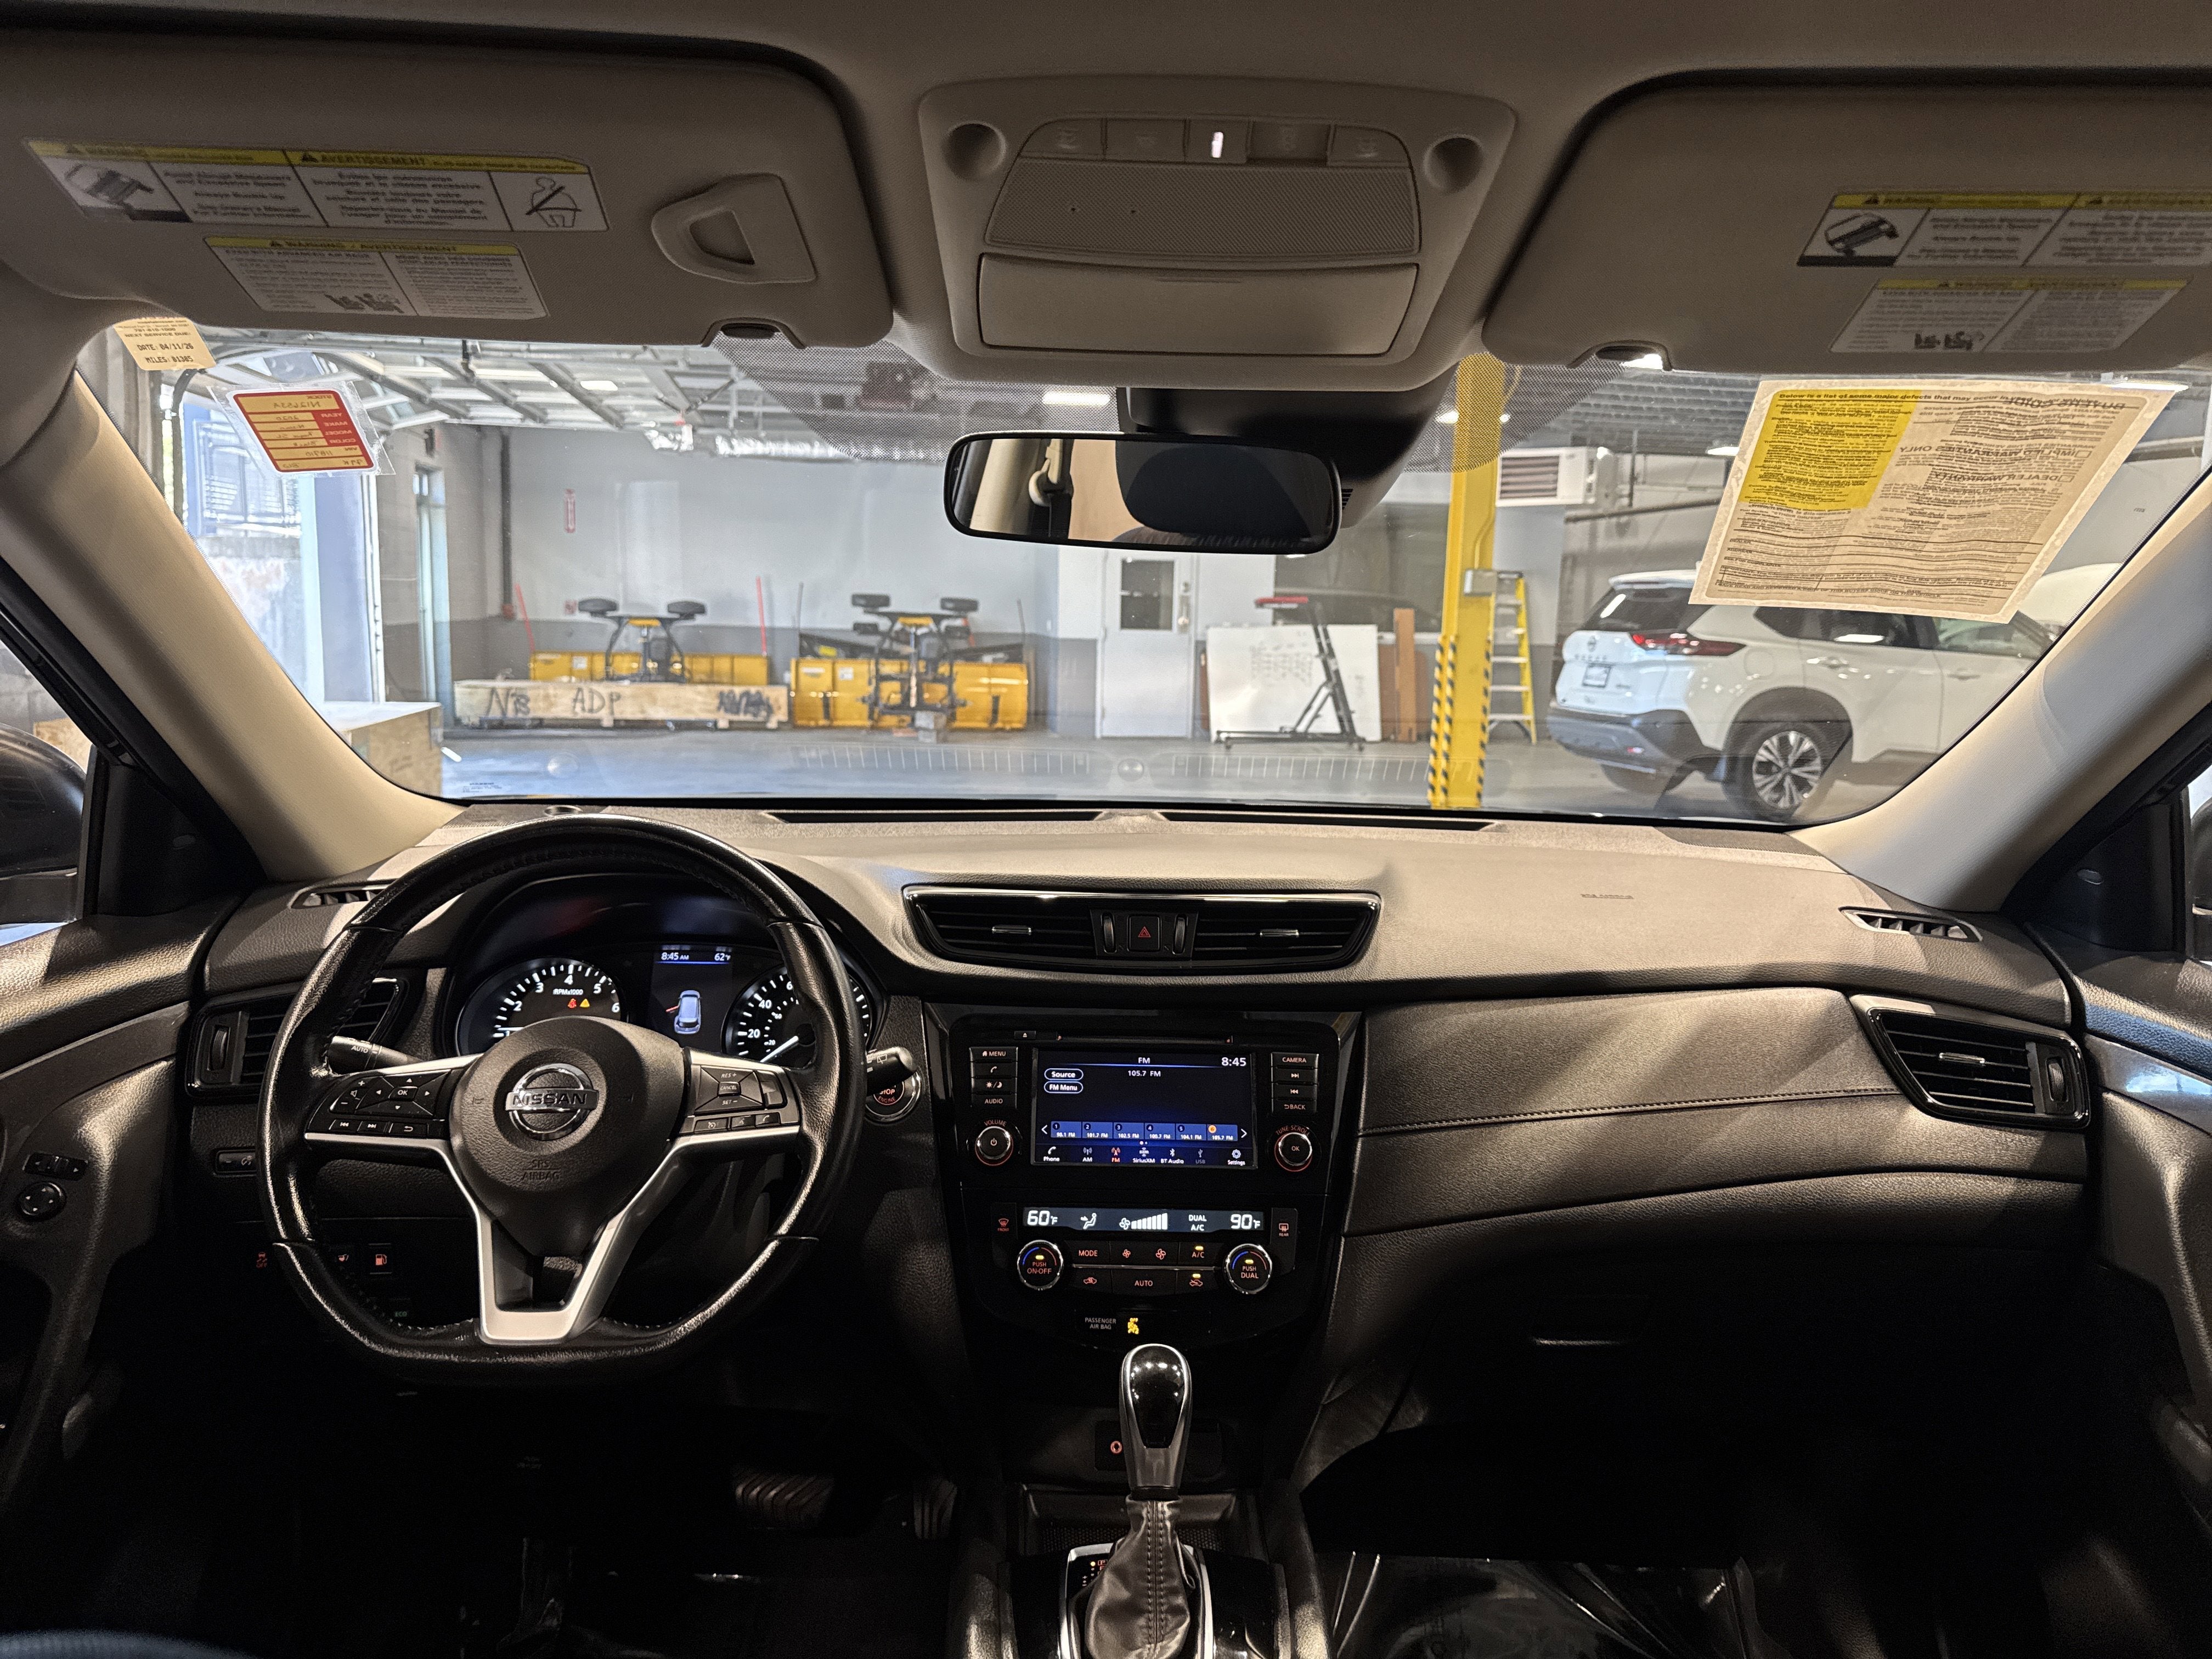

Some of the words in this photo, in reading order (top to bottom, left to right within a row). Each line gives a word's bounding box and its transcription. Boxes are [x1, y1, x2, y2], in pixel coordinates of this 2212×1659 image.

[661, 952, 679, 961] 8:45
[564, 974, 574, 985] 4
[535, 983, 544, 994] 3
[594, 983, 602, 994] 5
[514, 1001, 522, 1011] 2
[611, 1002, 620, 1013] 6
[759, 998, 772, 1009] 40
[748, 1028, 761, 1039] 20
[351, 1045, 369, 1054] AUTO
[1221, 1057, 1247, 1067] 8:45
[512, 1091, 588, 1106] NISSAN
[531, 1158, 550, 1169] SRS
[521, 1171, 561, 1182] AIRBAG
